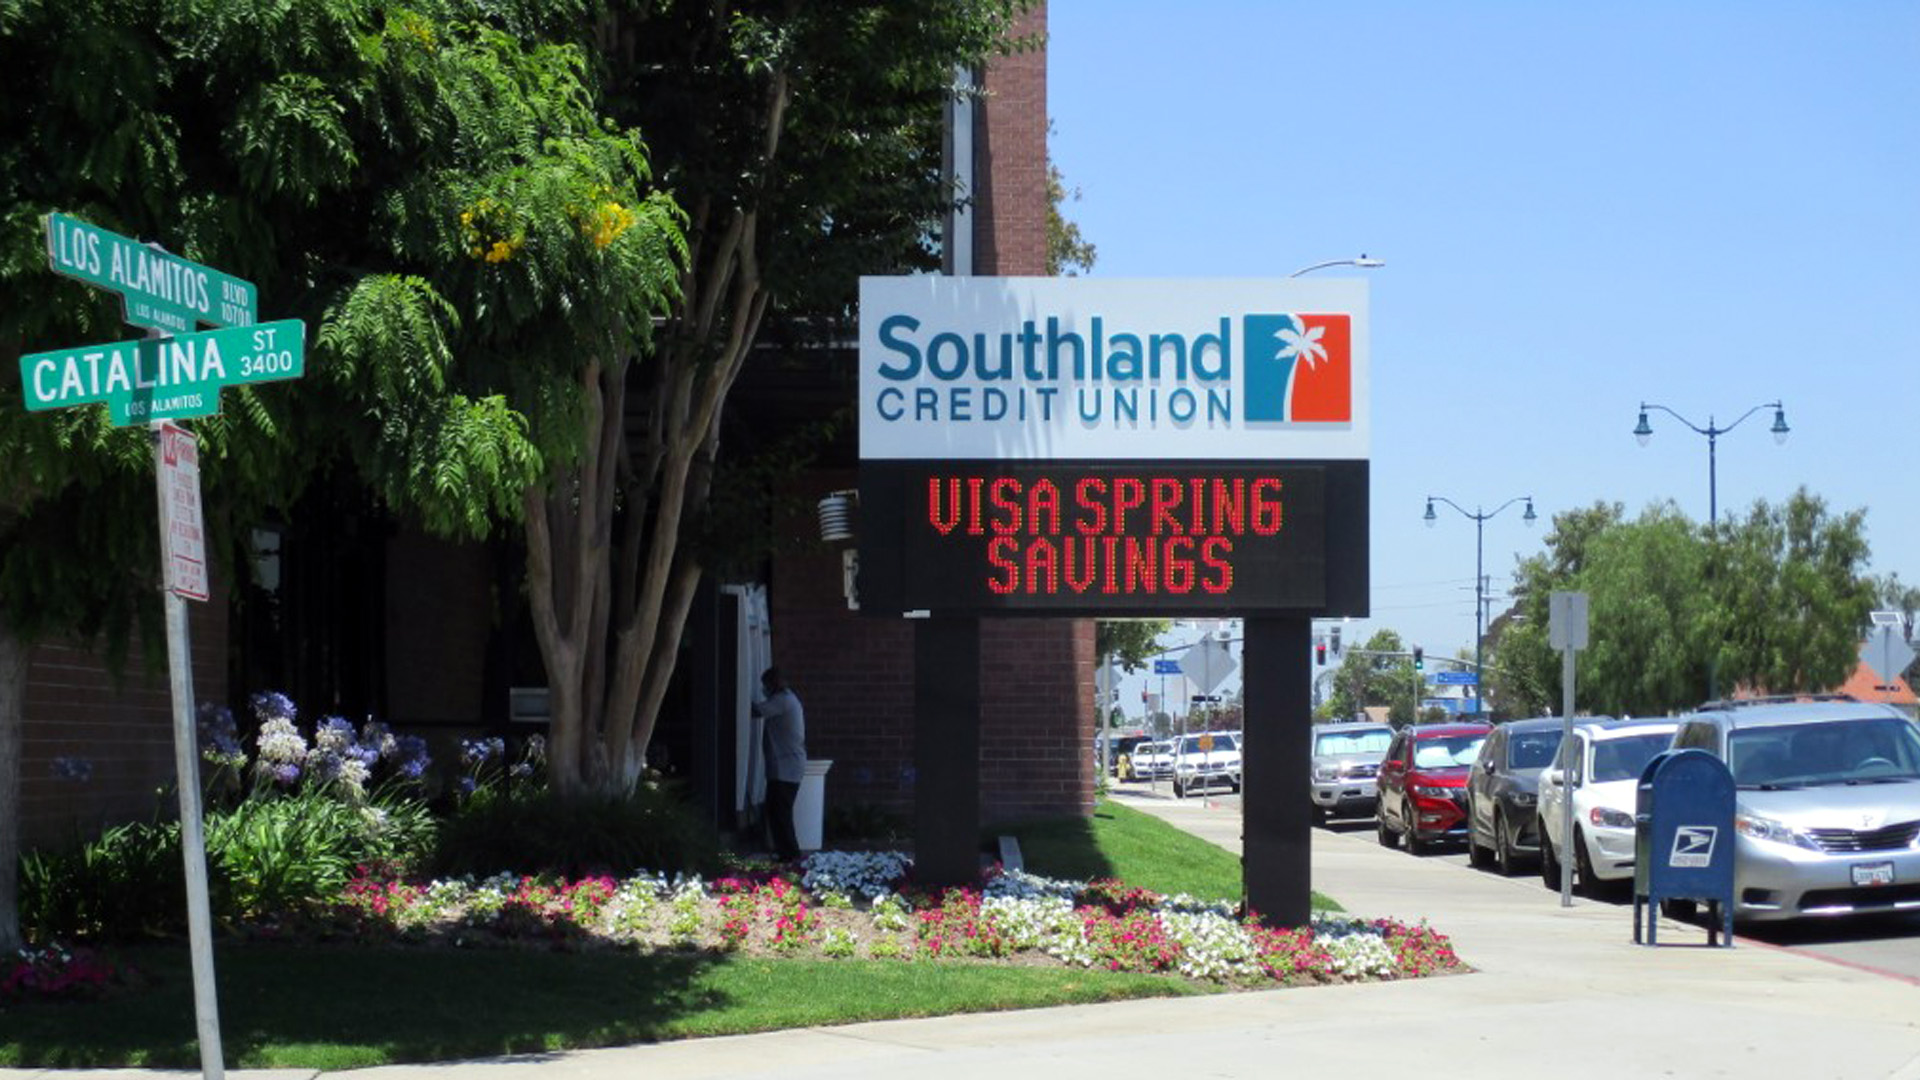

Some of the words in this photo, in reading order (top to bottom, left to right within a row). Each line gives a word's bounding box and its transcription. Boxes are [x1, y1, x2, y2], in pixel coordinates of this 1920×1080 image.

[60, 222, 100, 275] LOS
[110, 242, 209, 313] ALAMITOS
[222, 281, 248, 306] BLVD
[135, 303, 150, 319] LOS
[153, 307, 186, 332] ALAMITOS
[253, 328, 276, 351] ST
[33, 338, 226, 401] CATALINA
[240, 350, 292, 376] 3400
[877, 315, 1231, 382] Southland
[125, 401, 145, 417] LOS
[151, 394, 202, 411] ALAMITOS
[876, 387, 1058, 421] CREDIT
[1078, 387, 1231, 422] UNION
[929, 478, 1060, 535] VISA
[1075, 478, 1283, 535] SPRING
[987, 536, 1234, 595] SAVINGS
